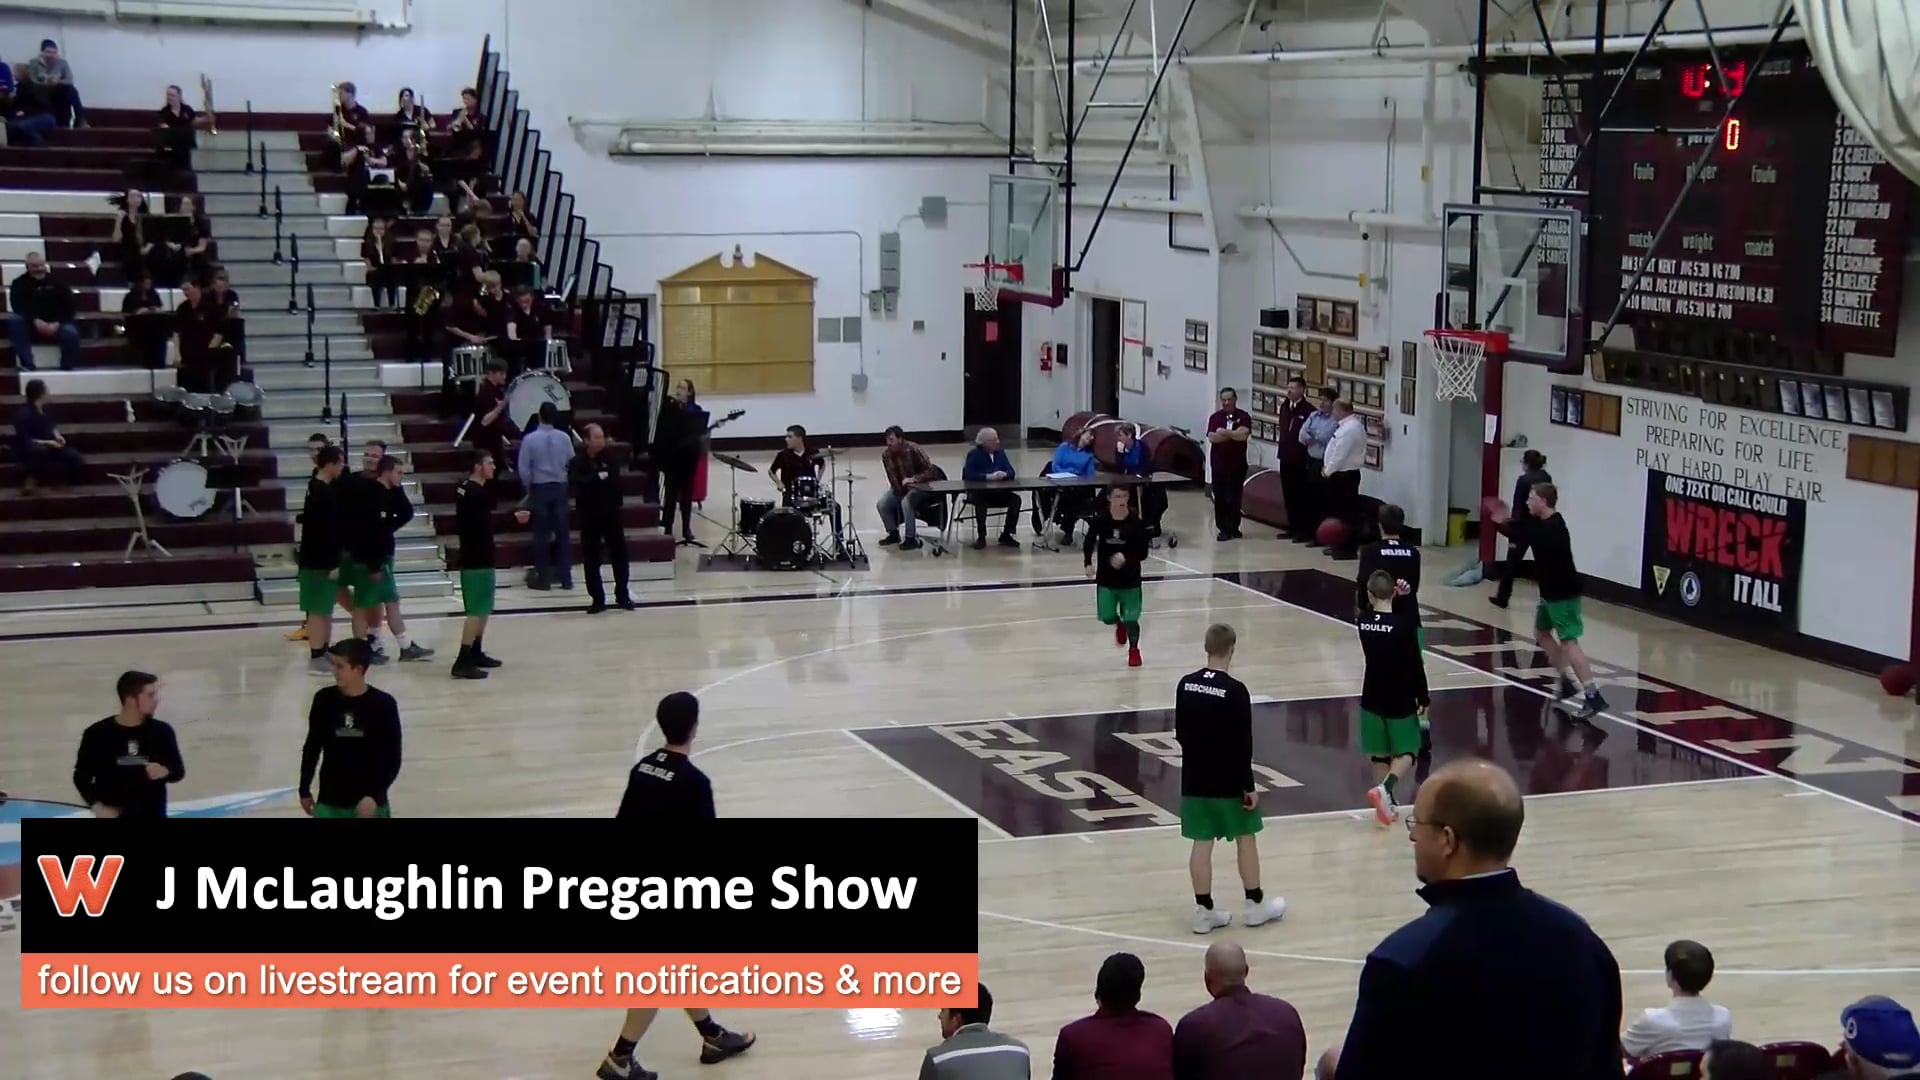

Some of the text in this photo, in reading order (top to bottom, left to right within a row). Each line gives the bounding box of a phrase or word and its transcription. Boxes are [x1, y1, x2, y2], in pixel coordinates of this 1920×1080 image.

[1726, 119, 1740, 150] 0
[1832, 147, 1844, 163] 12
[1829, 183, 1840, 200] 15
[1825, 219, 1838, 235] 22
[1824, 236, 1837, 253] 23
[1823, 254, 1835, 270] 24
[1822, 271, 1834, 288] 25
[1821, 288, 1834, 306] 33
[1820, 306, 1832, 323] 34
[1626, 396, 1847, 452] STRIVING FOR EXCELLENCE,
[1645, 425, 1724, 456] PREPARING
[1735, 441, 1764, 463] FOR
[1635, 448, 1671, 473] PLAY
[1733, 467, 1773, 495] PLAY
[1664, 475, 1789, 517] ONE TEXT OR CALL COULD
[1665, 497, 1788, 579] WRECK
[1732, 573, 1752, 604] IT
[1751, 578, 1782, 613] ALL
